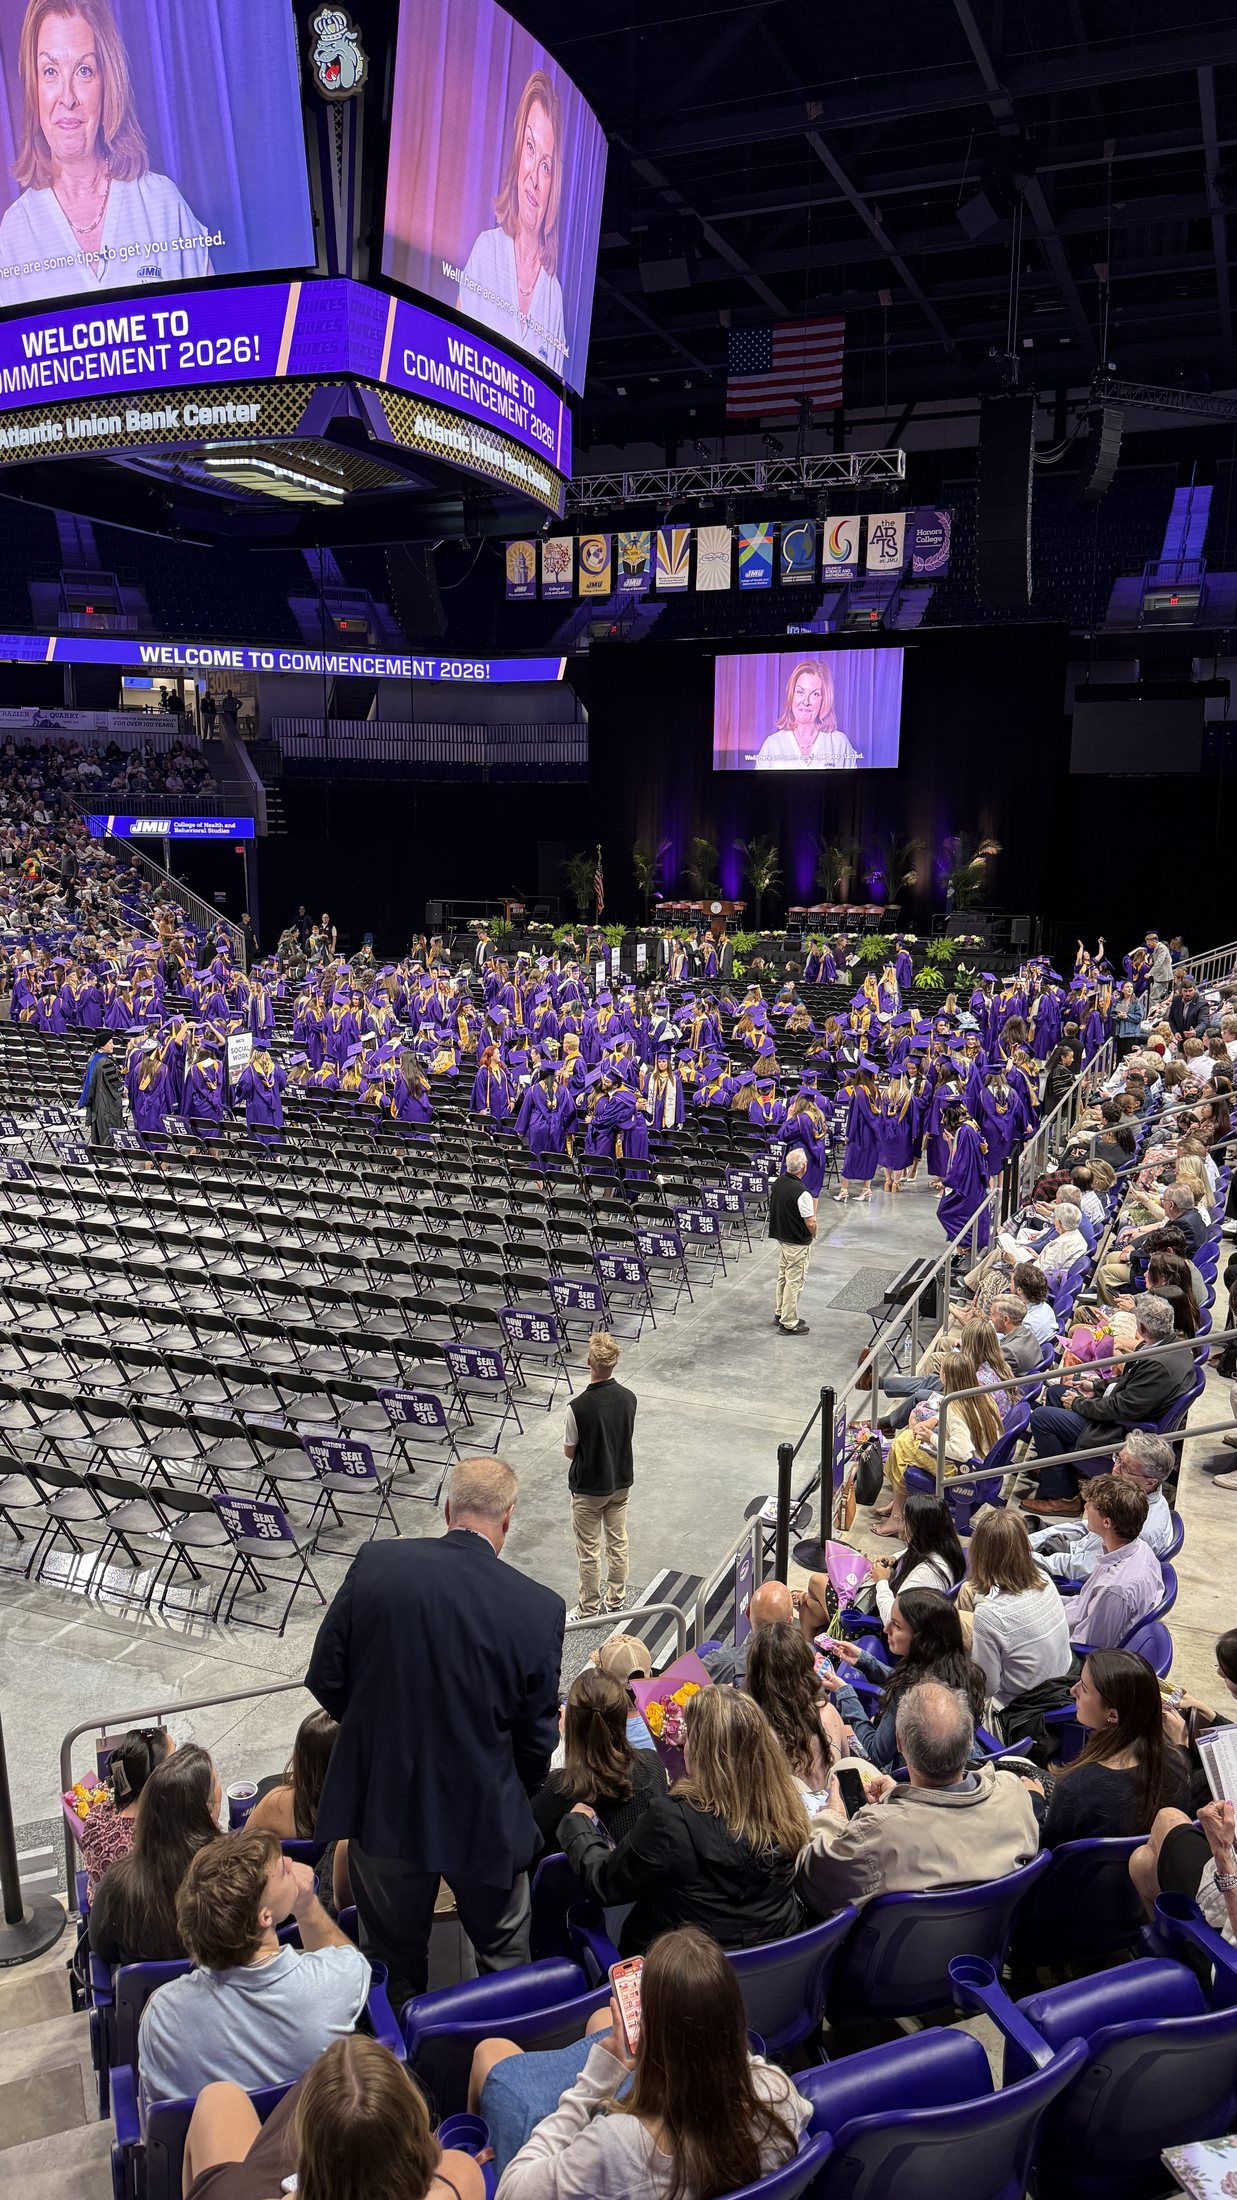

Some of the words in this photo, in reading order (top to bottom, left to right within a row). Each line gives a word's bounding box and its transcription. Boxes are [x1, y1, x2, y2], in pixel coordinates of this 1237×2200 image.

[23, 260, 41, 273] are
[44, 254, 74, 269] some
[77, 250, 100, 266] tips
[103, 247, 116, 260] to
[120, 244, 141, 262] get
[144, 242, 168, 258] you
[172, 230, 226, 250] started.
[464, 276, 482, 294] here
[483, 290, 496, 303] are
[496, 297, 514, 314] some
[22, 315, 146, 358] WELCOME
[152, 310, 188, 338] TO
[179, 335, 261, 368] 2026!
[447, 336, 519, 398] WELCOME
[521, 379, 535, 409] TO
[403, 349, 529, 431] COMMENCEMENT
[530, 415, 554, 451] 2026!
[0, 419, 63, 449] Atlantic
[66, 413, 122, 438] Union
[125, 406, 180, 432] Bank
[184, 402, 261, 426] Center
[414, 415, 470, 452] Atlantic
[472, 435, 504, 468] Union
[504, 451, 528, 481] Bank
[528, 464, 550, 496] Center
[881, 519, 896, 527] the
[869, 525, 897, 546] AR
[916, 528, 942, 536] Honors
[916, 536, 943, 544] College
[876, 538, 898, 558] TS
[745, 569, 764, 577] JMU
[587, 581, 603, 589] JMU
[623, 578, 642, 587] JMU
[139, 645, 244, 667] WELCOME
[248, 652, 274, 669] TO
[279, 653, 435, 677] COMMENCEMENT
[440, 662, 490, 679] 2026!
[130, 819, 171, 834] JMU
[231, 1045, 249, 1054] SOCIAL
[233, 1053, 248, 1061] WORK
[50, 1116, 61, 1124] 18
[4, 1127, 15, 1135] 18
[129, 1140, 140, 1149] 19
[77, 1155, 89, 1163] 19
[16, 1170, 27, 1179] 19
[757, 1165, 769, 1175] 21
[730, 1181, 743, 1191] 22
[749, 1184, 763, 1192] 36
[706, 1199, 719, 1209] 23
[726, 1202, 739, 1211] 36
[679, 1219, 692, 1231] 24
[700, 1223, 714, 1233] 36
[640, 1243, 653, 1254] 25
[661, 1247, 677, 1257] 36
[601, 1266, 616, 1278] 26
[625, 1270, 640, 1281] 36
[554, 1285, 570, 1295] ROW
[578, 1290, 595, 1299] SEAT
[554, 1293, 569, 1306] 27
[578, 1299, 596, 1310] 36
[505, 1317, 522, 1327] ROW
[531, 1321, 549, 1329] SEAT
[507, 1325, 524, 1338] 28
[531, 1329, 550, 1341] 36
[449, 1352, 467, 1363] ROW
[476, 1357, 495, 1366] SEAT
[451, 1361, 470, 1375] 29
[478, 1366, 498, 1378] 36
[384, 1398, 402, 1409] ROW
[413, 1402, 433, 1412] SEAT
[387, 1407, 407, 1421] 30
[416, 1411, 438, 1424] 36
[321, 1440, 342, 1449] SECTION
[309, 1445, 329, 1458] ROW
[341, 1451, 362, 1461] SEAT
[312, 1455, 332, 1471] 31
[343, 1461, 367, 1475] 36
[952, 1487, 974, 1497] JMU
[231, 1501, 252, 1510] SECTION
[219, 1505, 240, 1520] ROW
[252, 1512, 276, 1524] SEAT
[223, 1515, 245, 1534] 32
[256, 1523, 282, 1538] 36
